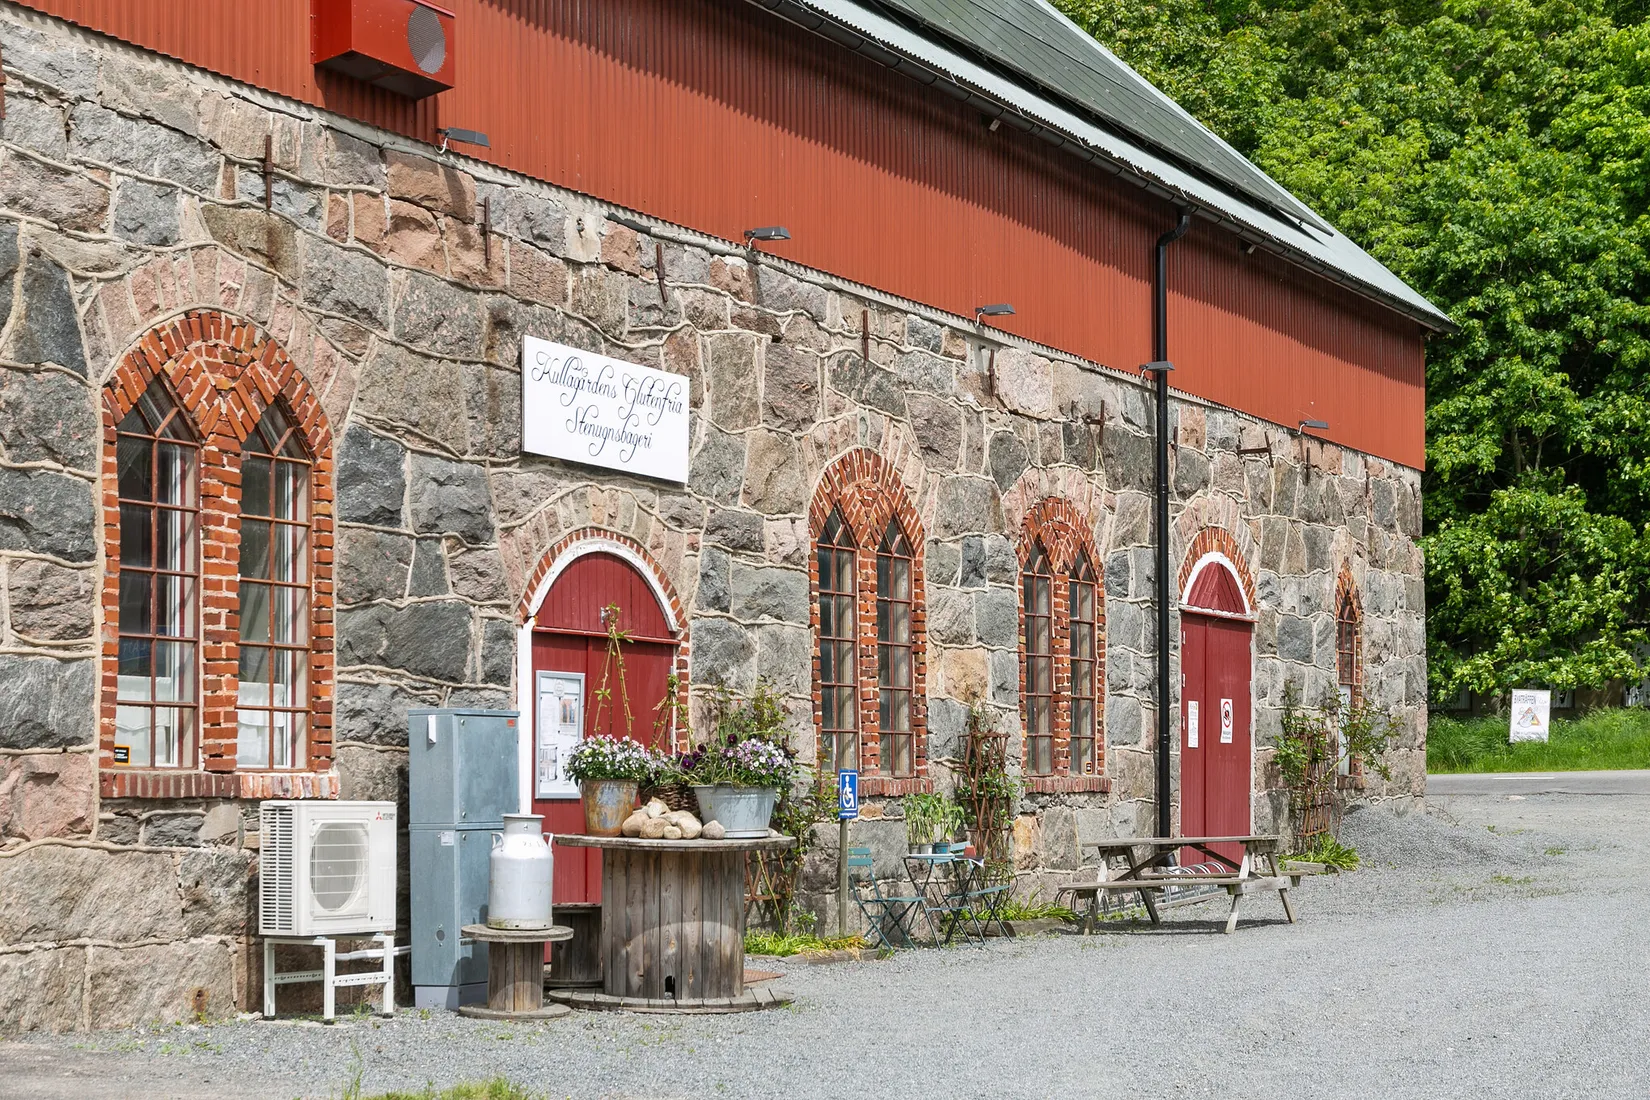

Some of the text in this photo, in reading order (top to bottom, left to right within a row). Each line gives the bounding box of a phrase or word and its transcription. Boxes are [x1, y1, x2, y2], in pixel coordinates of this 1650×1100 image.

[531, 351, 684, 426] Kullagårdens Glutenfria
[565, 404, 653, 463] Stenugnsbageri
